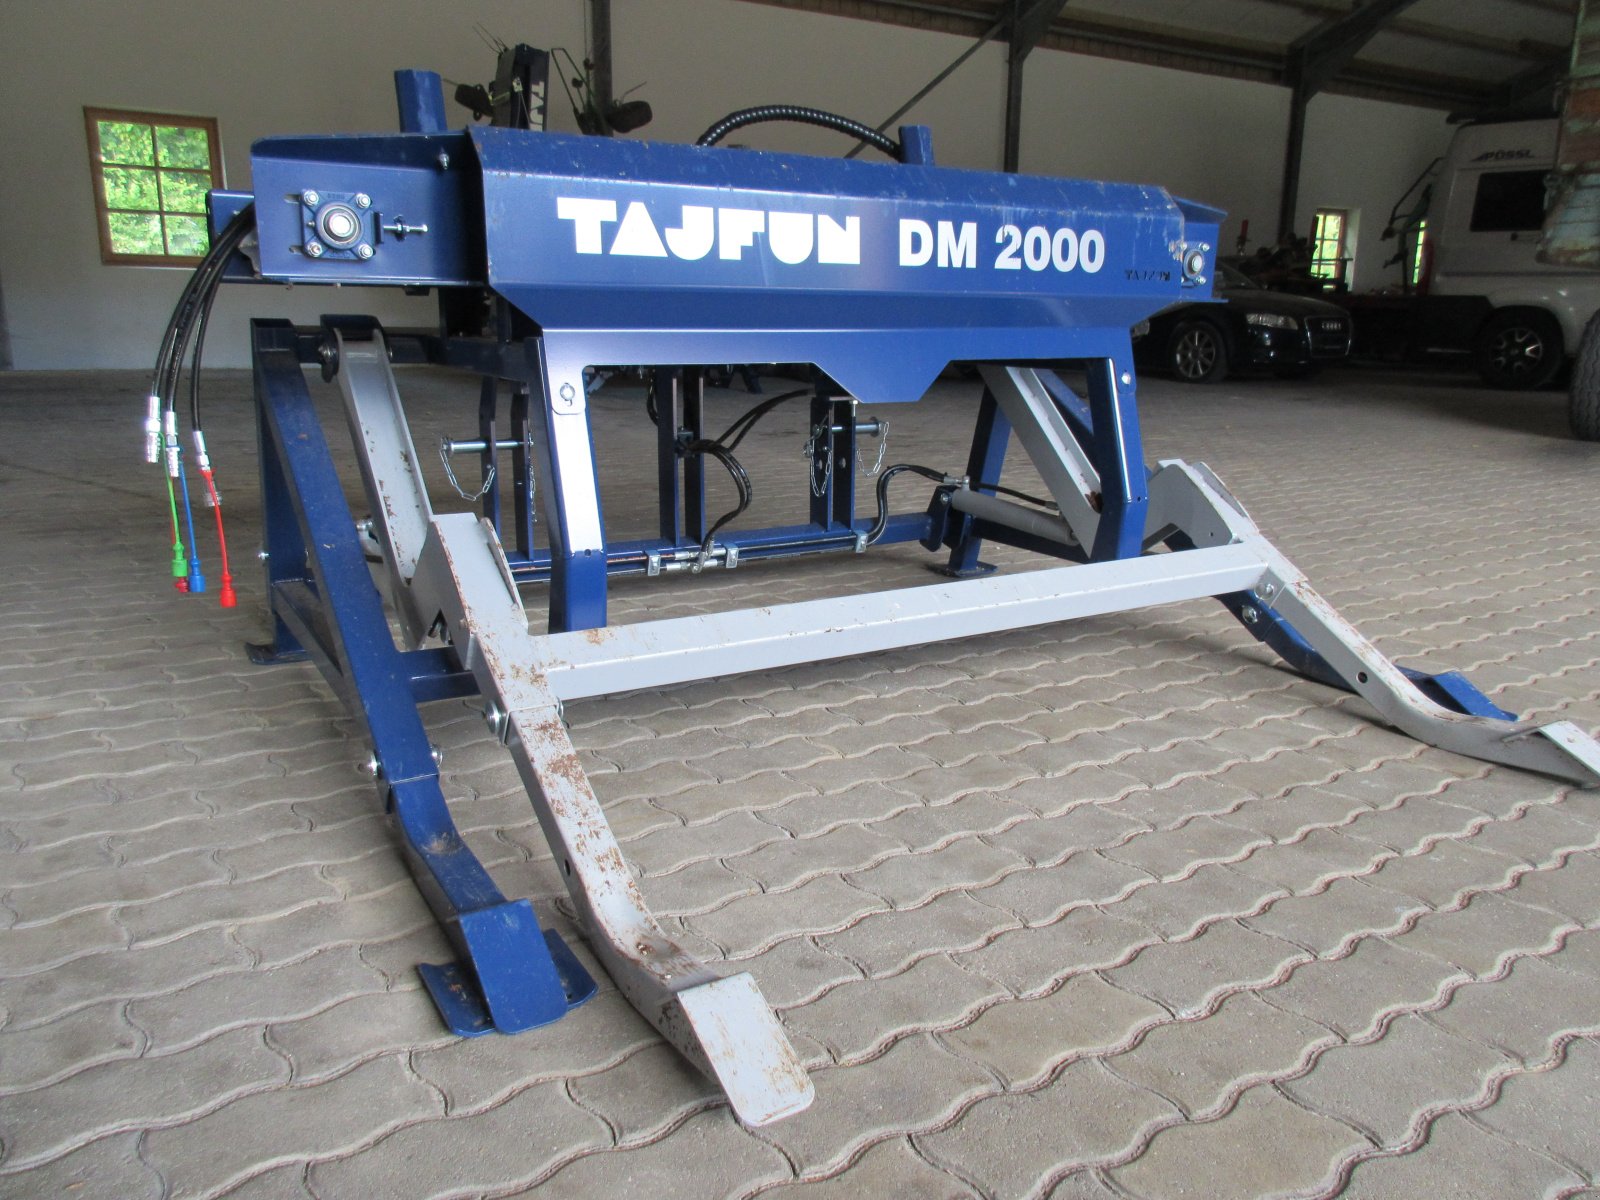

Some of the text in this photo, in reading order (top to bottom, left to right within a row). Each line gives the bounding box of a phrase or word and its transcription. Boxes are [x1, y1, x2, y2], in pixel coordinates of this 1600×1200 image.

[557, 197, 1105, 273] TAJFUN DM 2000
